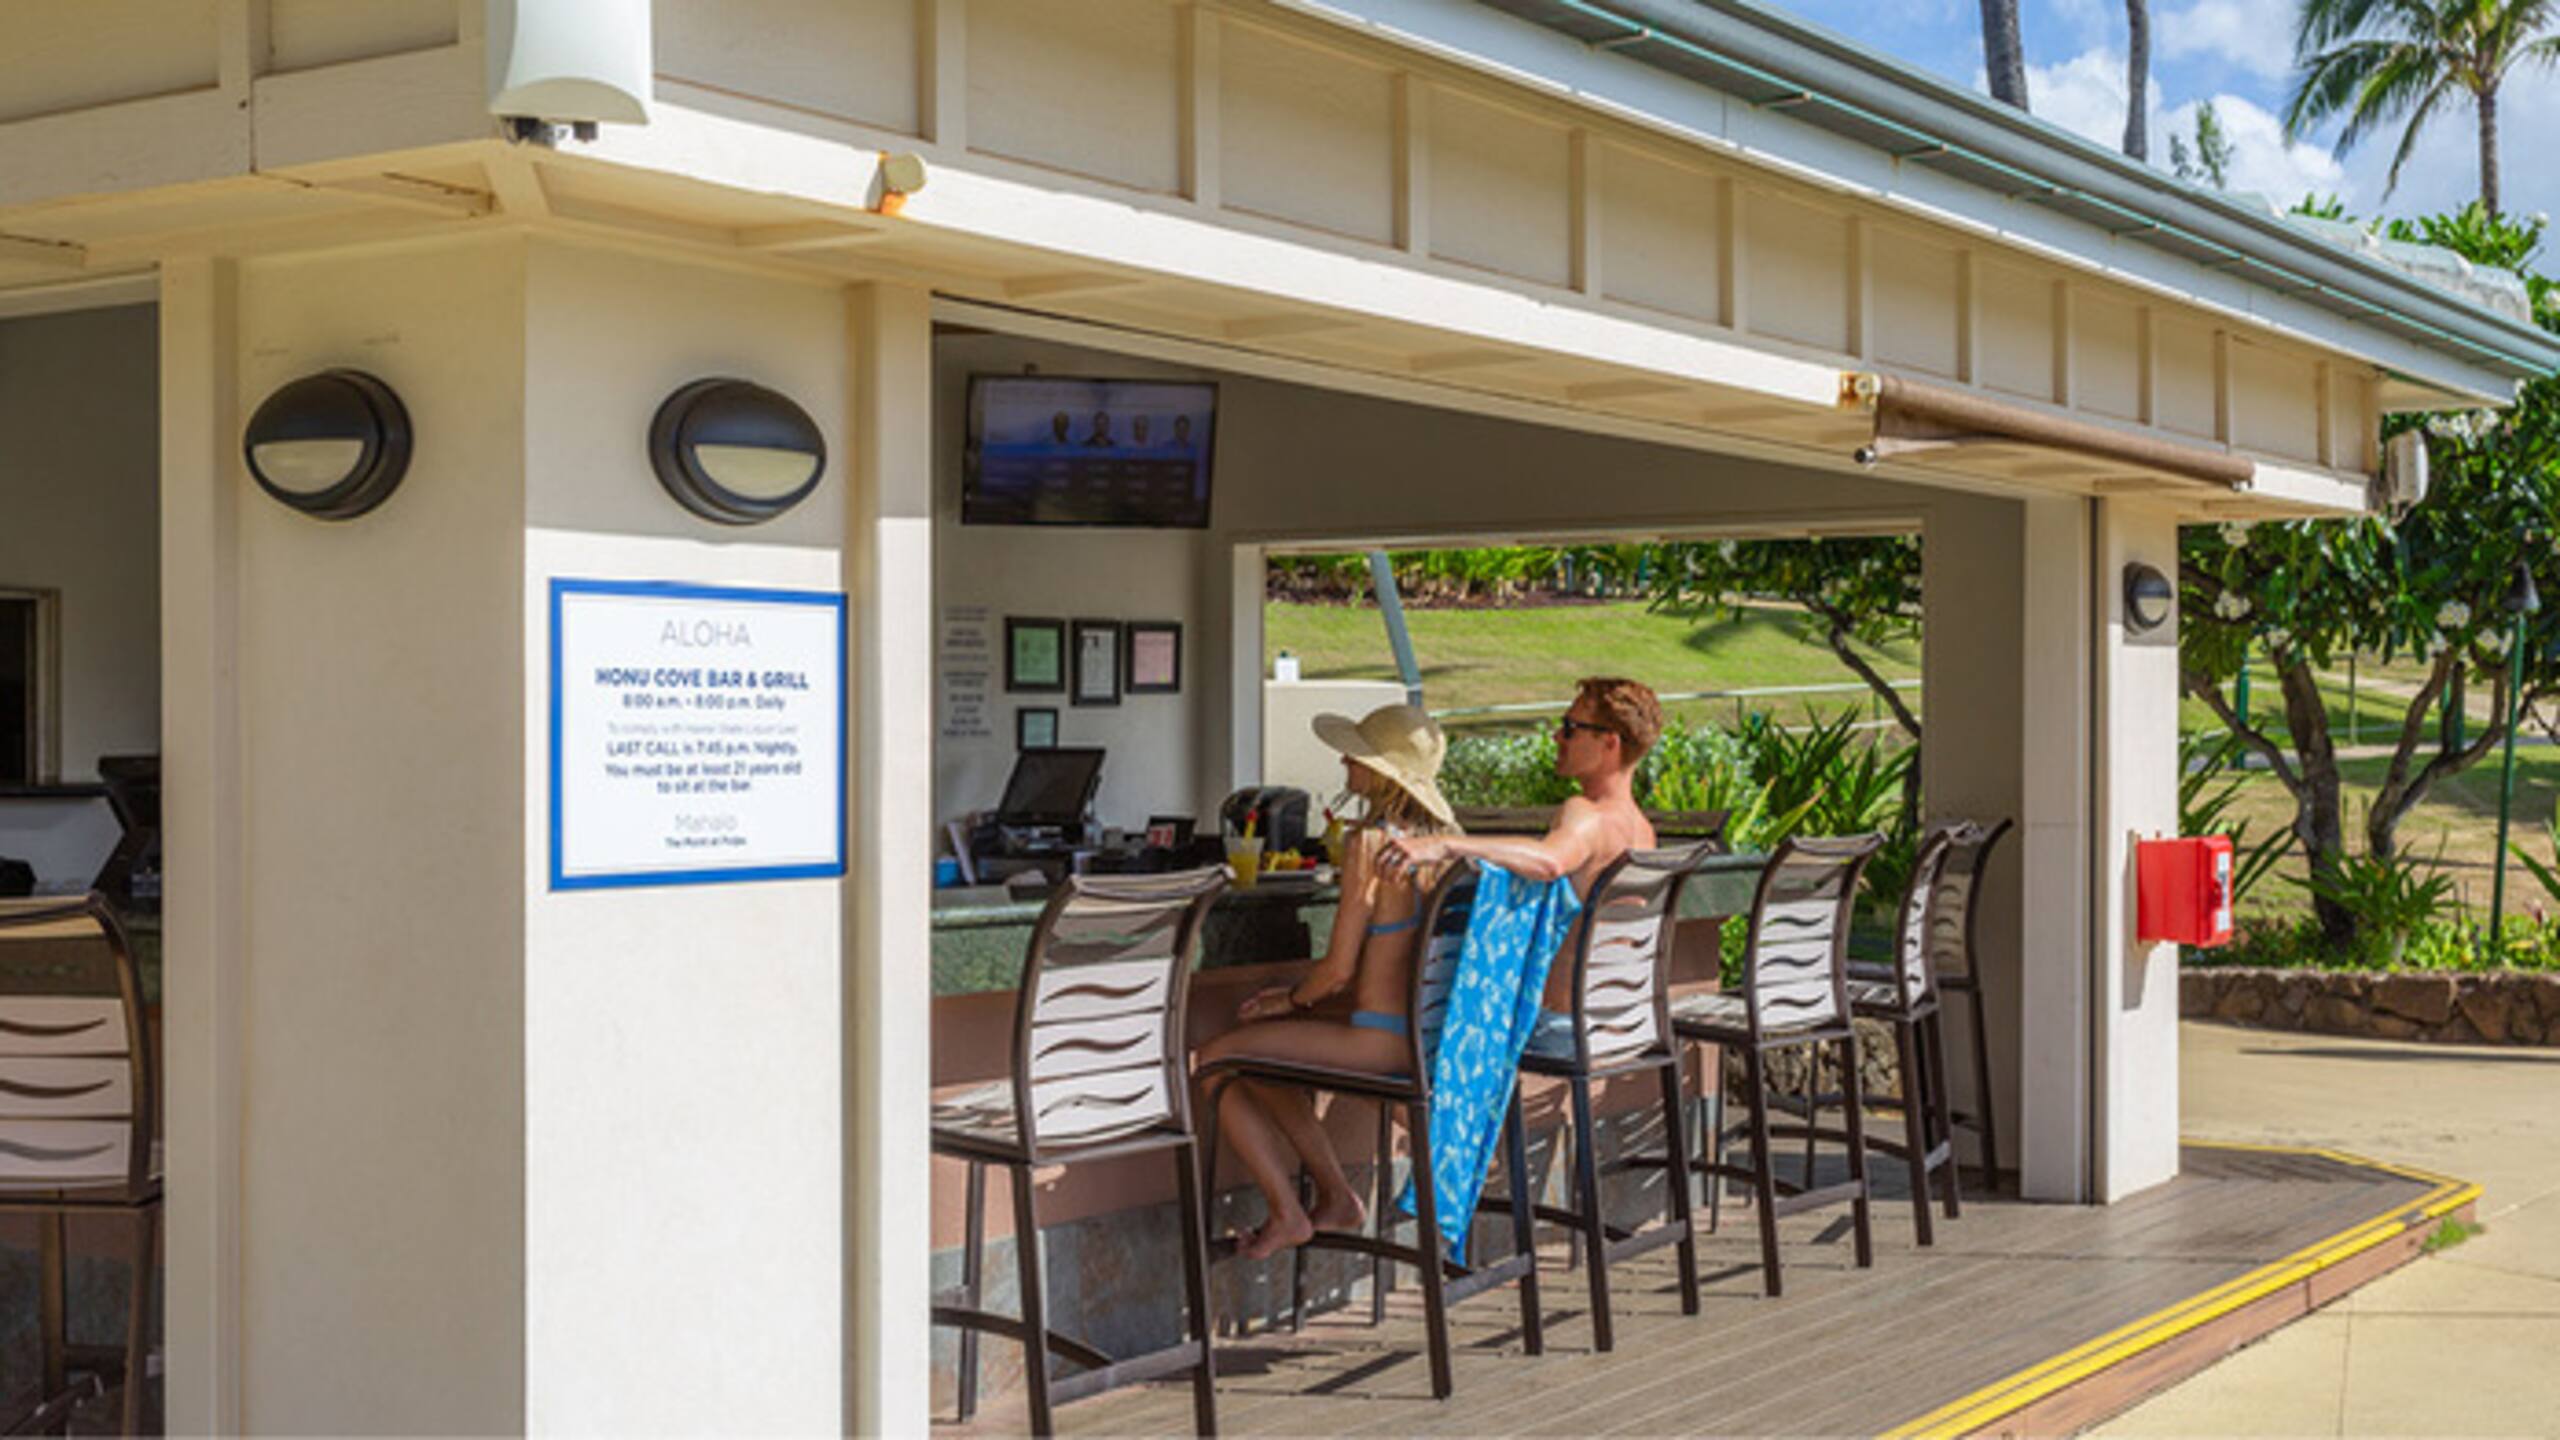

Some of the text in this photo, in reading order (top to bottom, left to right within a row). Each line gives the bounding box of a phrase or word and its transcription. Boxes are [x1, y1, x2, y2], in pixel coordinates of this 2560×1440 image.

[661, 618, 752, 647] ALOHA
[654, 668, 702, 687] COVE
[708, 669, 742, 687] BAR
[746, 671, 757, 688] &
[762, 671, 810, 690] GRILL
[607, 741, 641, 756] LAST
[645, 741, 679, 757] CALL
[605, 761, 802, 777] You must be at least 21 years old
[657, 780, 671, 793] to
[675, 779, 689, 793] sit
[693, 780, 705, 793] at
[708, 778, 728, 793] the
